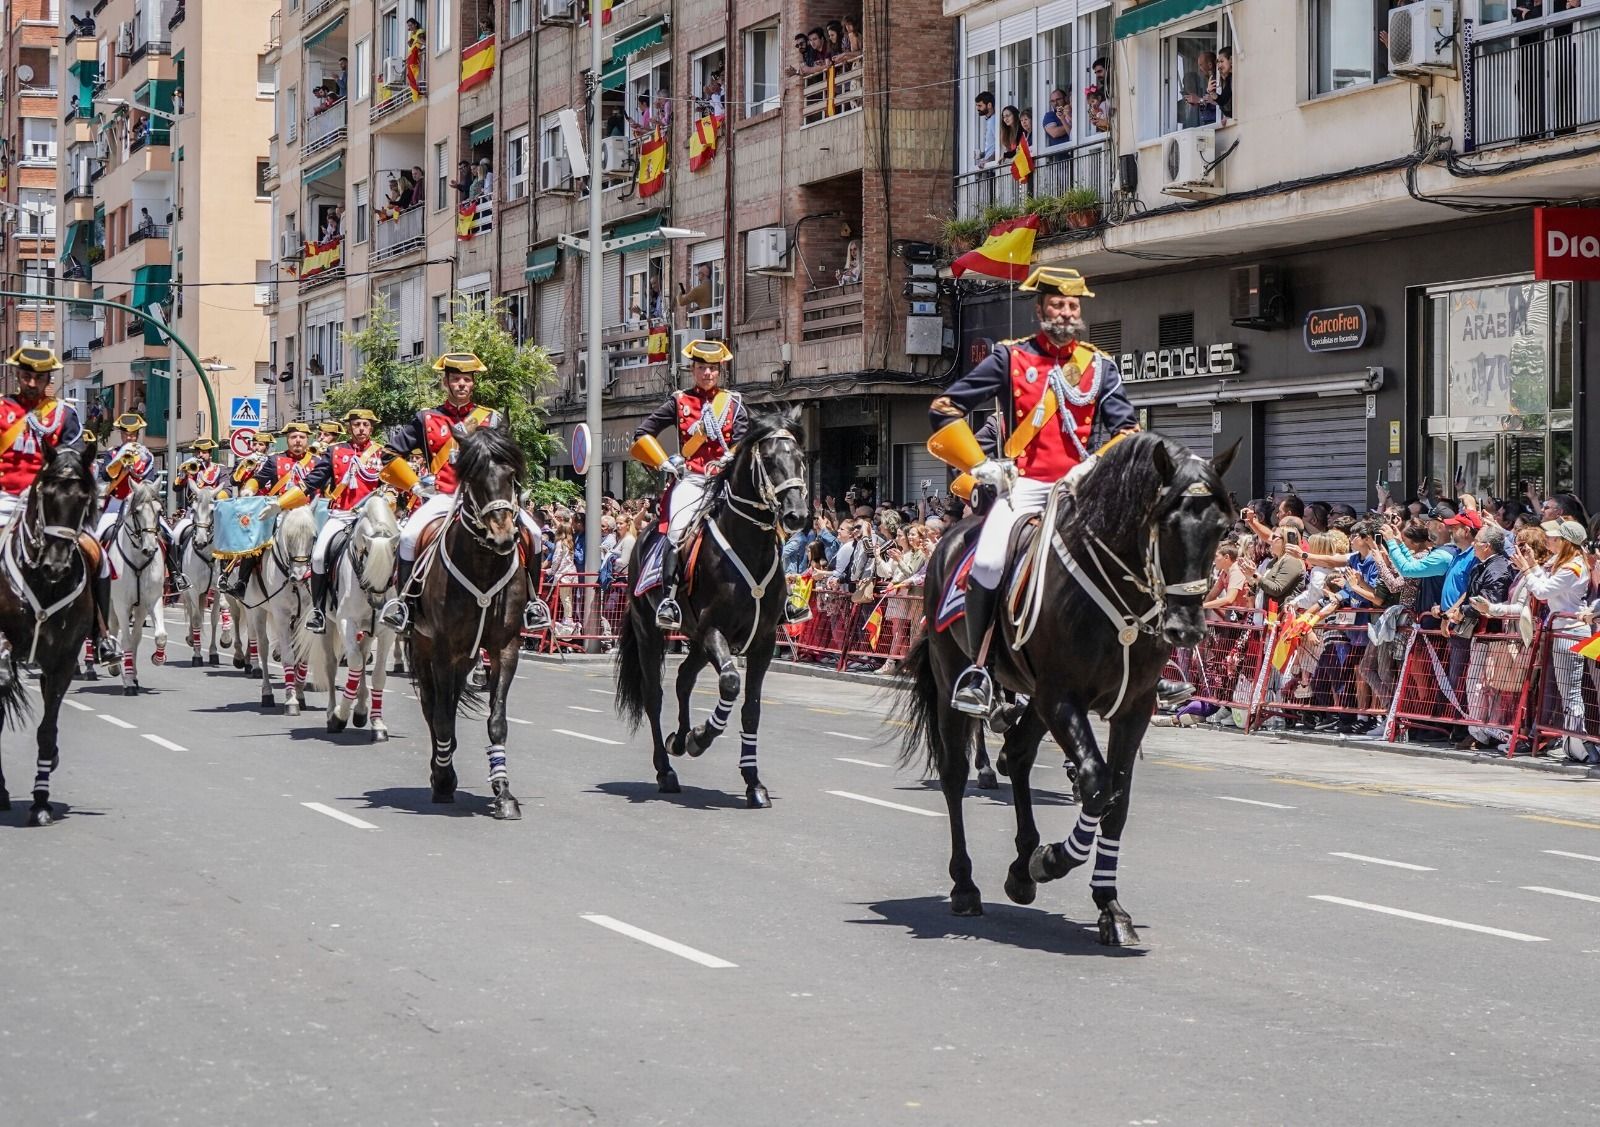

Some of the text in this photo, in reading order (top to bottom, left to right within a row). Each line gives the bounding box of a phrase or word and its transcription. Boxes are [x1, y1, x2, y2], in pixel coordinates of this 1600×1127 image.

[1311, 313, 1359, 334] GarcoFren
[1312, 337, 1333, 348] Especialistas
[1121, 342, 1234, 381] EMBRAGUES
